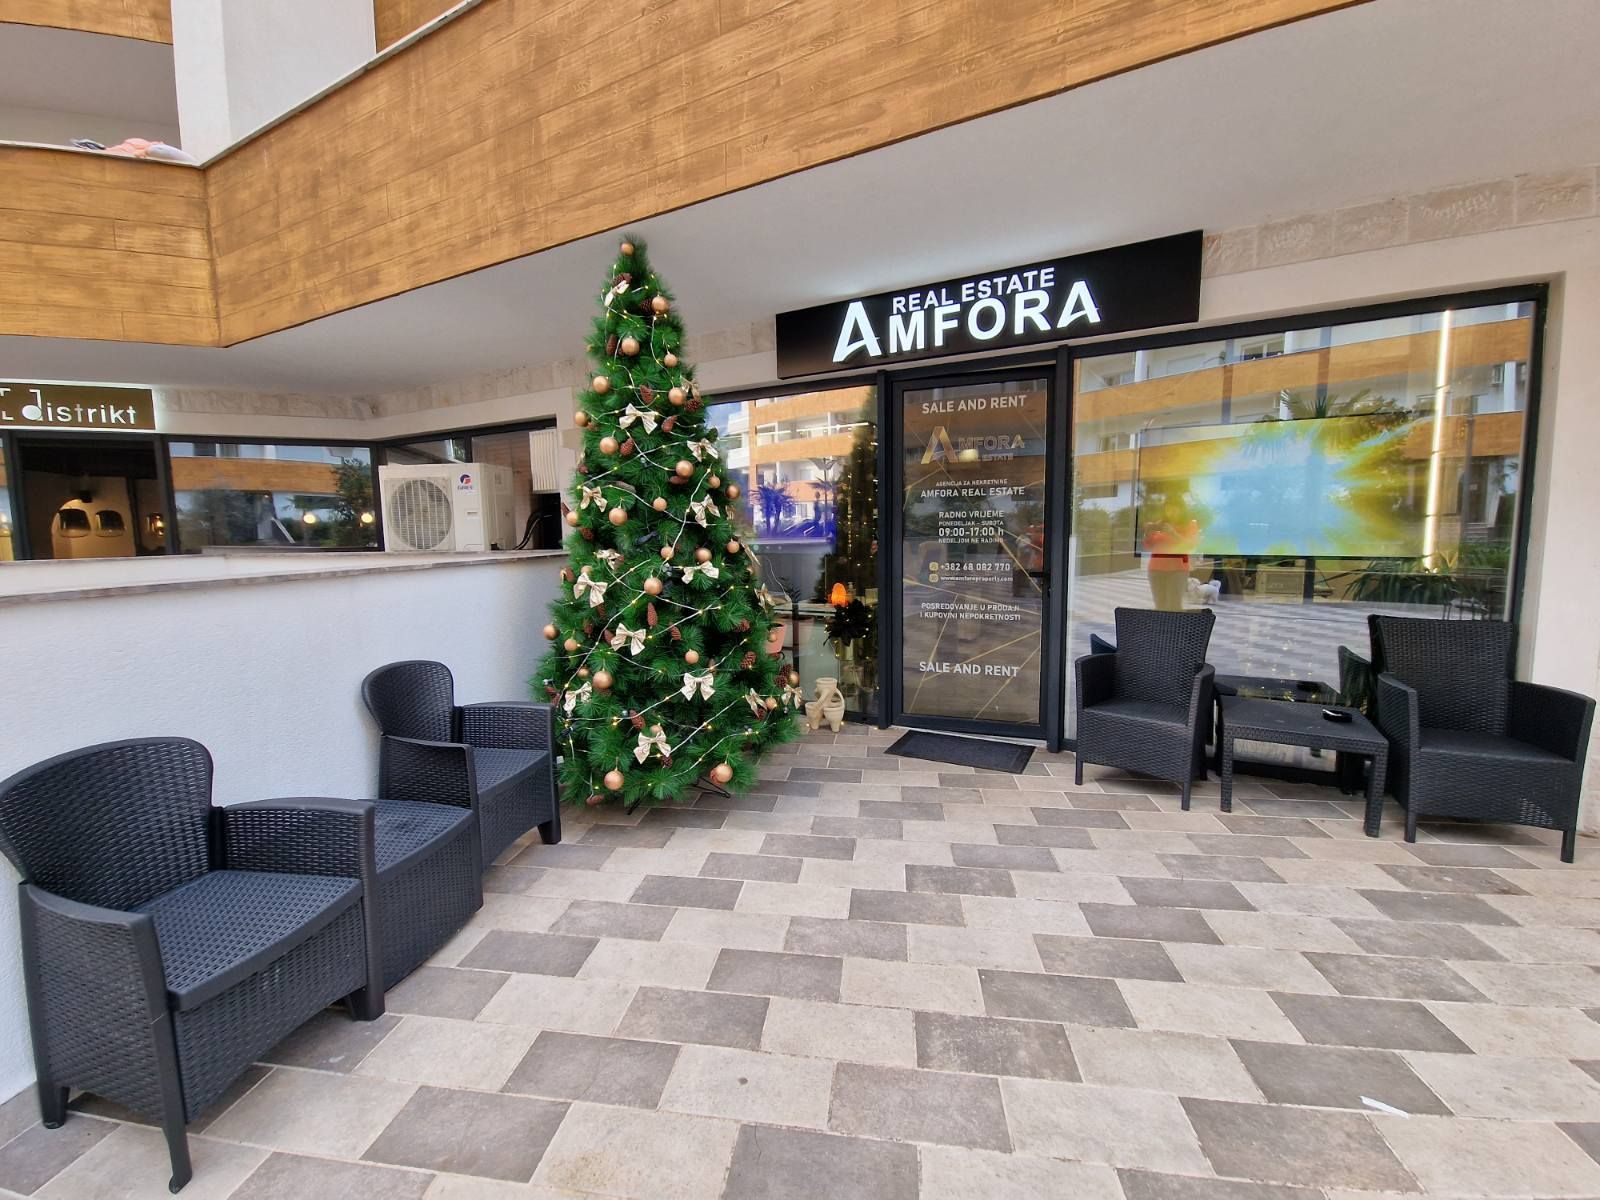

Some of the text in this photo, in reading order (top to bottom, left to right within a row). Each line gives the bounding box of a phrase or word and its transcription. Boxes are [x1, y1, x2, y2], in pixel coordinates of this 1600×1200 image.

[893, 267, 1056, 314] REAL ESTATE
[832, 281, 1101, 363] AMFORA
[21, 389, 137, 425] distrikt
[922, 395, 1027, 414] SALE AND RENT
[920, 425, 1026, 465] AMFORA
[920, 486, 1025, 498] AMFORA REAL ESTATE
[938, 510, 1004, 519] RADNO VRIJEME
[938, 527, 1004, 537] 09:00-17:00 h
[940, 563, 1011, 571] +382 68 082 770
[921, 602, 978, 611] POSREDOVANJE
[924, 611, 958, 619] KUPOVINI
[959, 612, 1021, 621] NEPOKRETNOSTI
[919, 661, 1021, 677] SALE AND RENT
